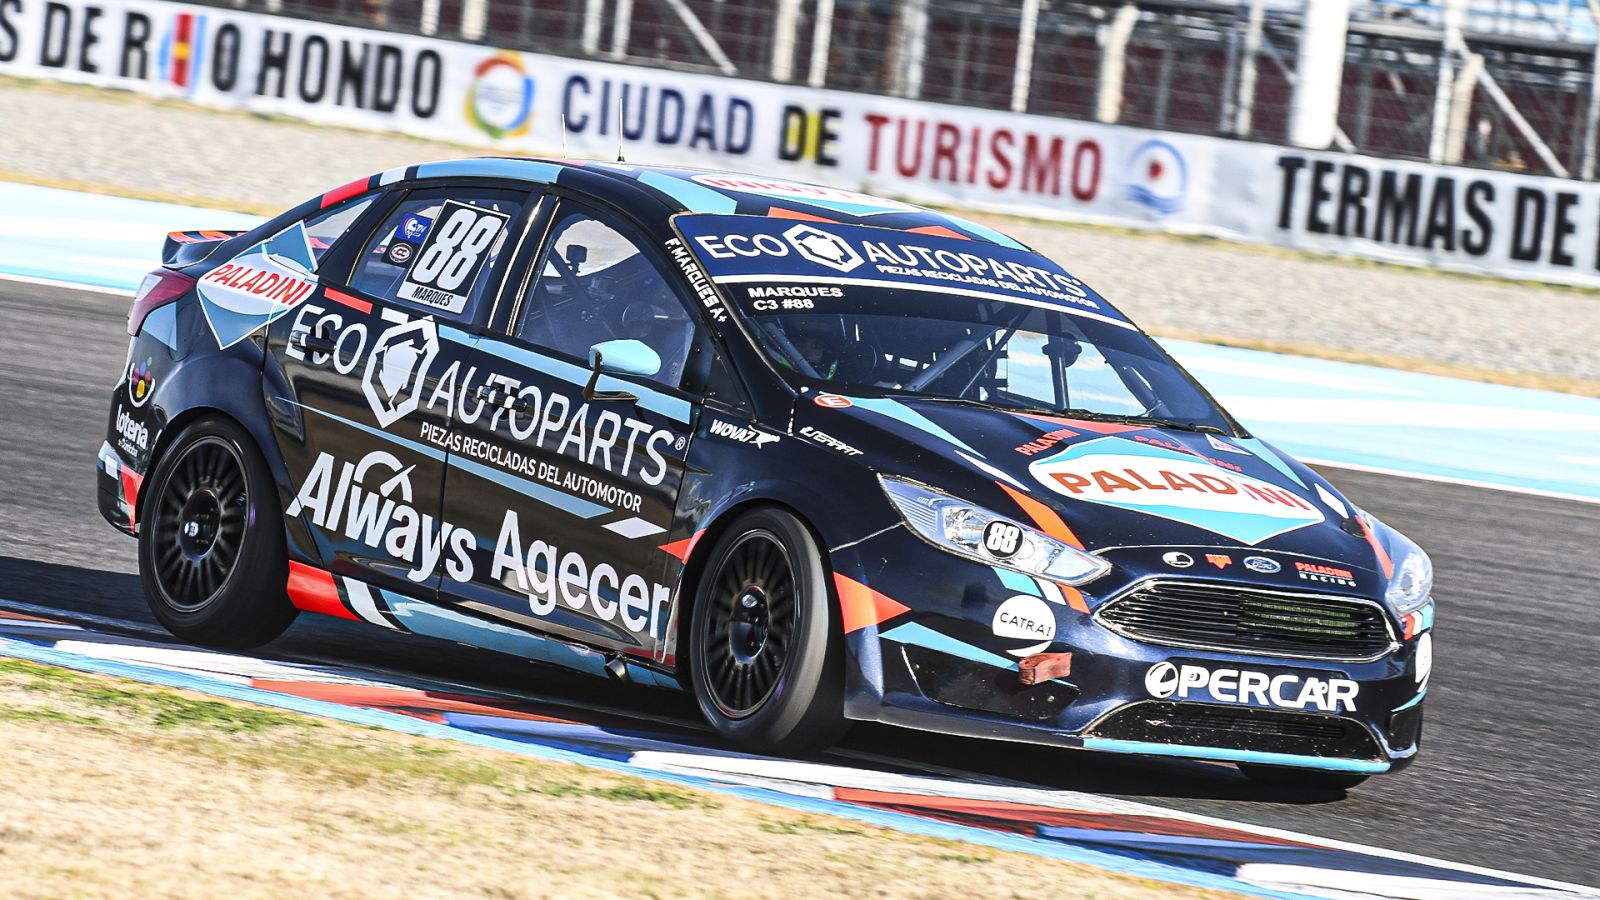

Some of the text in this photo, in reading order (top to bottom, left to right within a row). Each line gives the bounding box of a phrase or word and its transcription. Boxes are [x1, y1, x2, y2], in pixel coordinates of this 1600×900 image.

[40, 1, 103, 73] DE
[255, 29, 442, 118] HONDO
[562, 75, 1103, 201] CIUDAD DE TURISMO
[1277, 156, 1579, 266] TERMAS DE
[412, 208, 502, 290] 88
[694, 234, 789, 259] ECO
[204, 263, 313, 306] PALADINI
[411, 286, 454, 307] MARQUES
[747, 286, 844, 299] MARQUES
[753, 298, 815, 311] C3 #88
[876, 264, 1101, 310] PIEZAS RECICLADAS DEL AUTOMOTOR
[284, 302, 367, 375] ECO
[1014, 429, 1080, 456] PALADINI
[419, 423, 643, 513] PIEZAS RECICLADAS DEL AUTOMOTOR
[1048, 468, 1312, 511] PALADINI
[285, 451, 672, 638] Always Agecer
[986, 522, 1020, 554] 88
[1294, 562, 1353, 579] PALADINI
[1298, 572, 1357, 587] RACING
[1000, 612, 1051, 637] CATRAI
